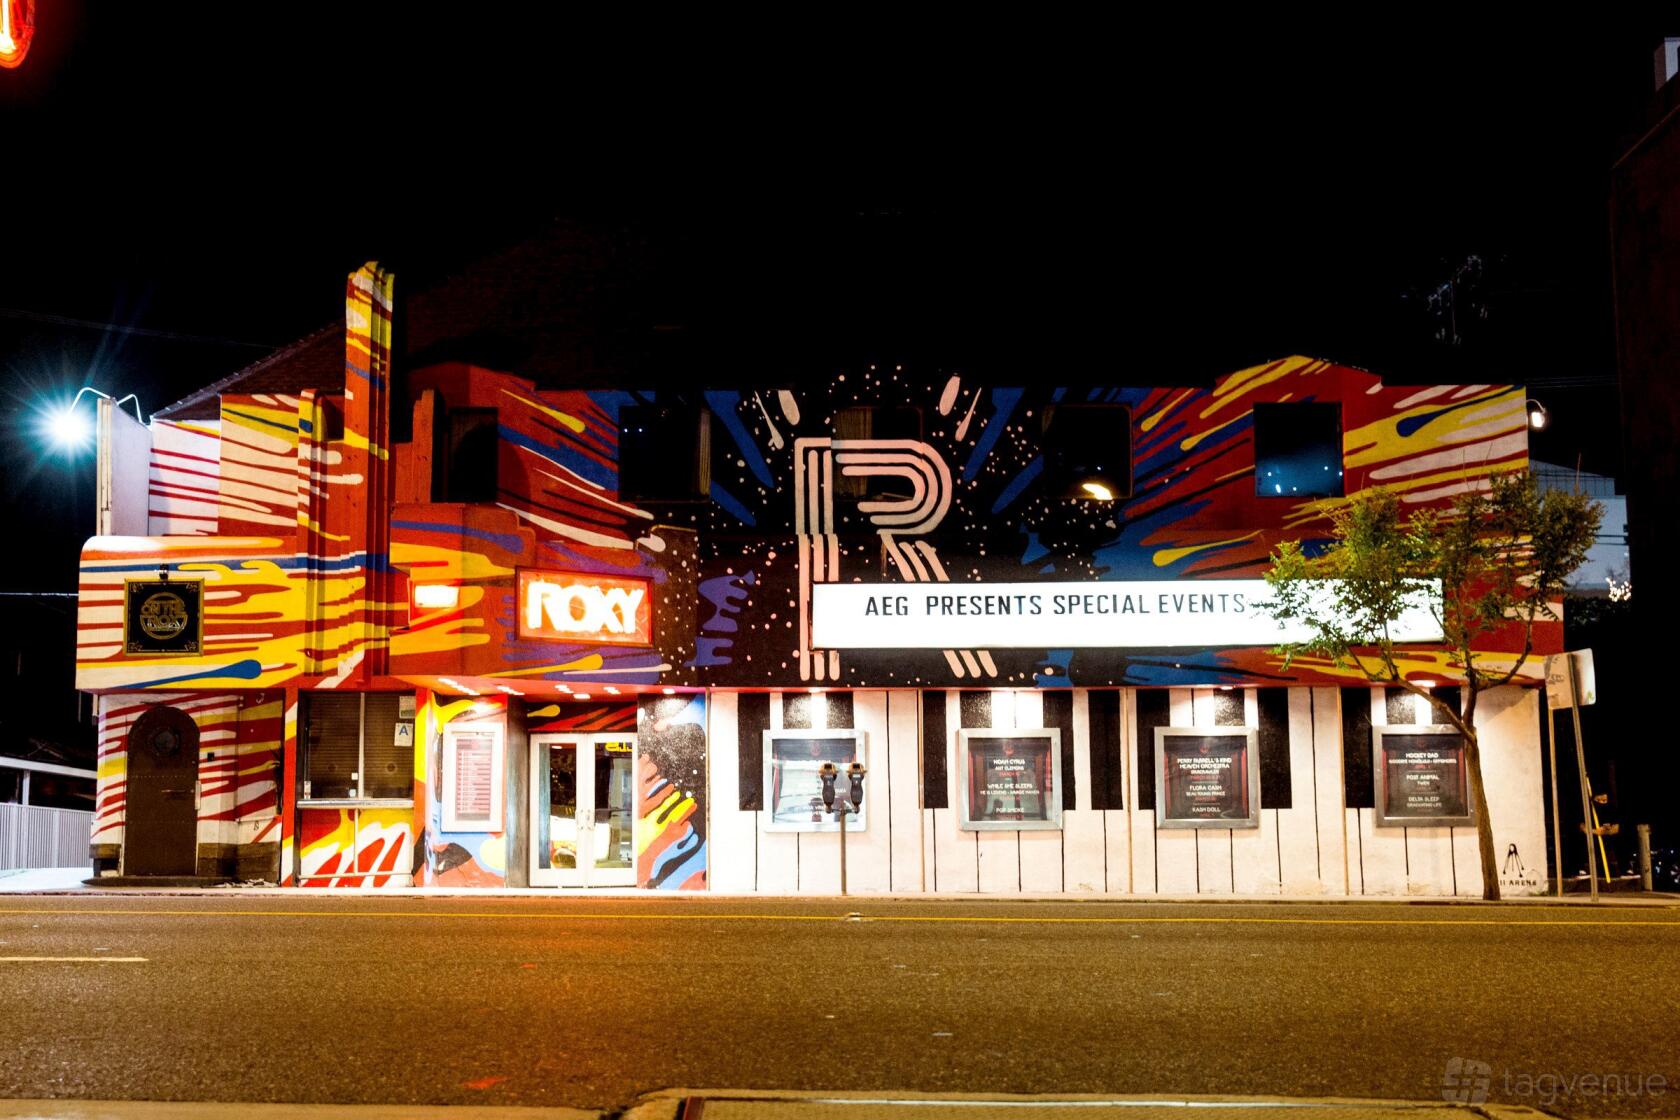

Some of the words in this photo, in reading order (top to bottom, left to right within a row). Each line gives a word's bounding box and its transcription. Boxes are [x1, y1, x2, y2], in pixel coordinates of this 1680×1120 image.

[527, 581, 645, 634] ROXY
[865, 596, 909, 616] AEG
[926, 595, 1042, 616] PRESENTS
[1053, 594, 1150, 615] SPECIAL
[1159, 593, 1245, 614] EVENTS
[399, 725, 409, 736] A
